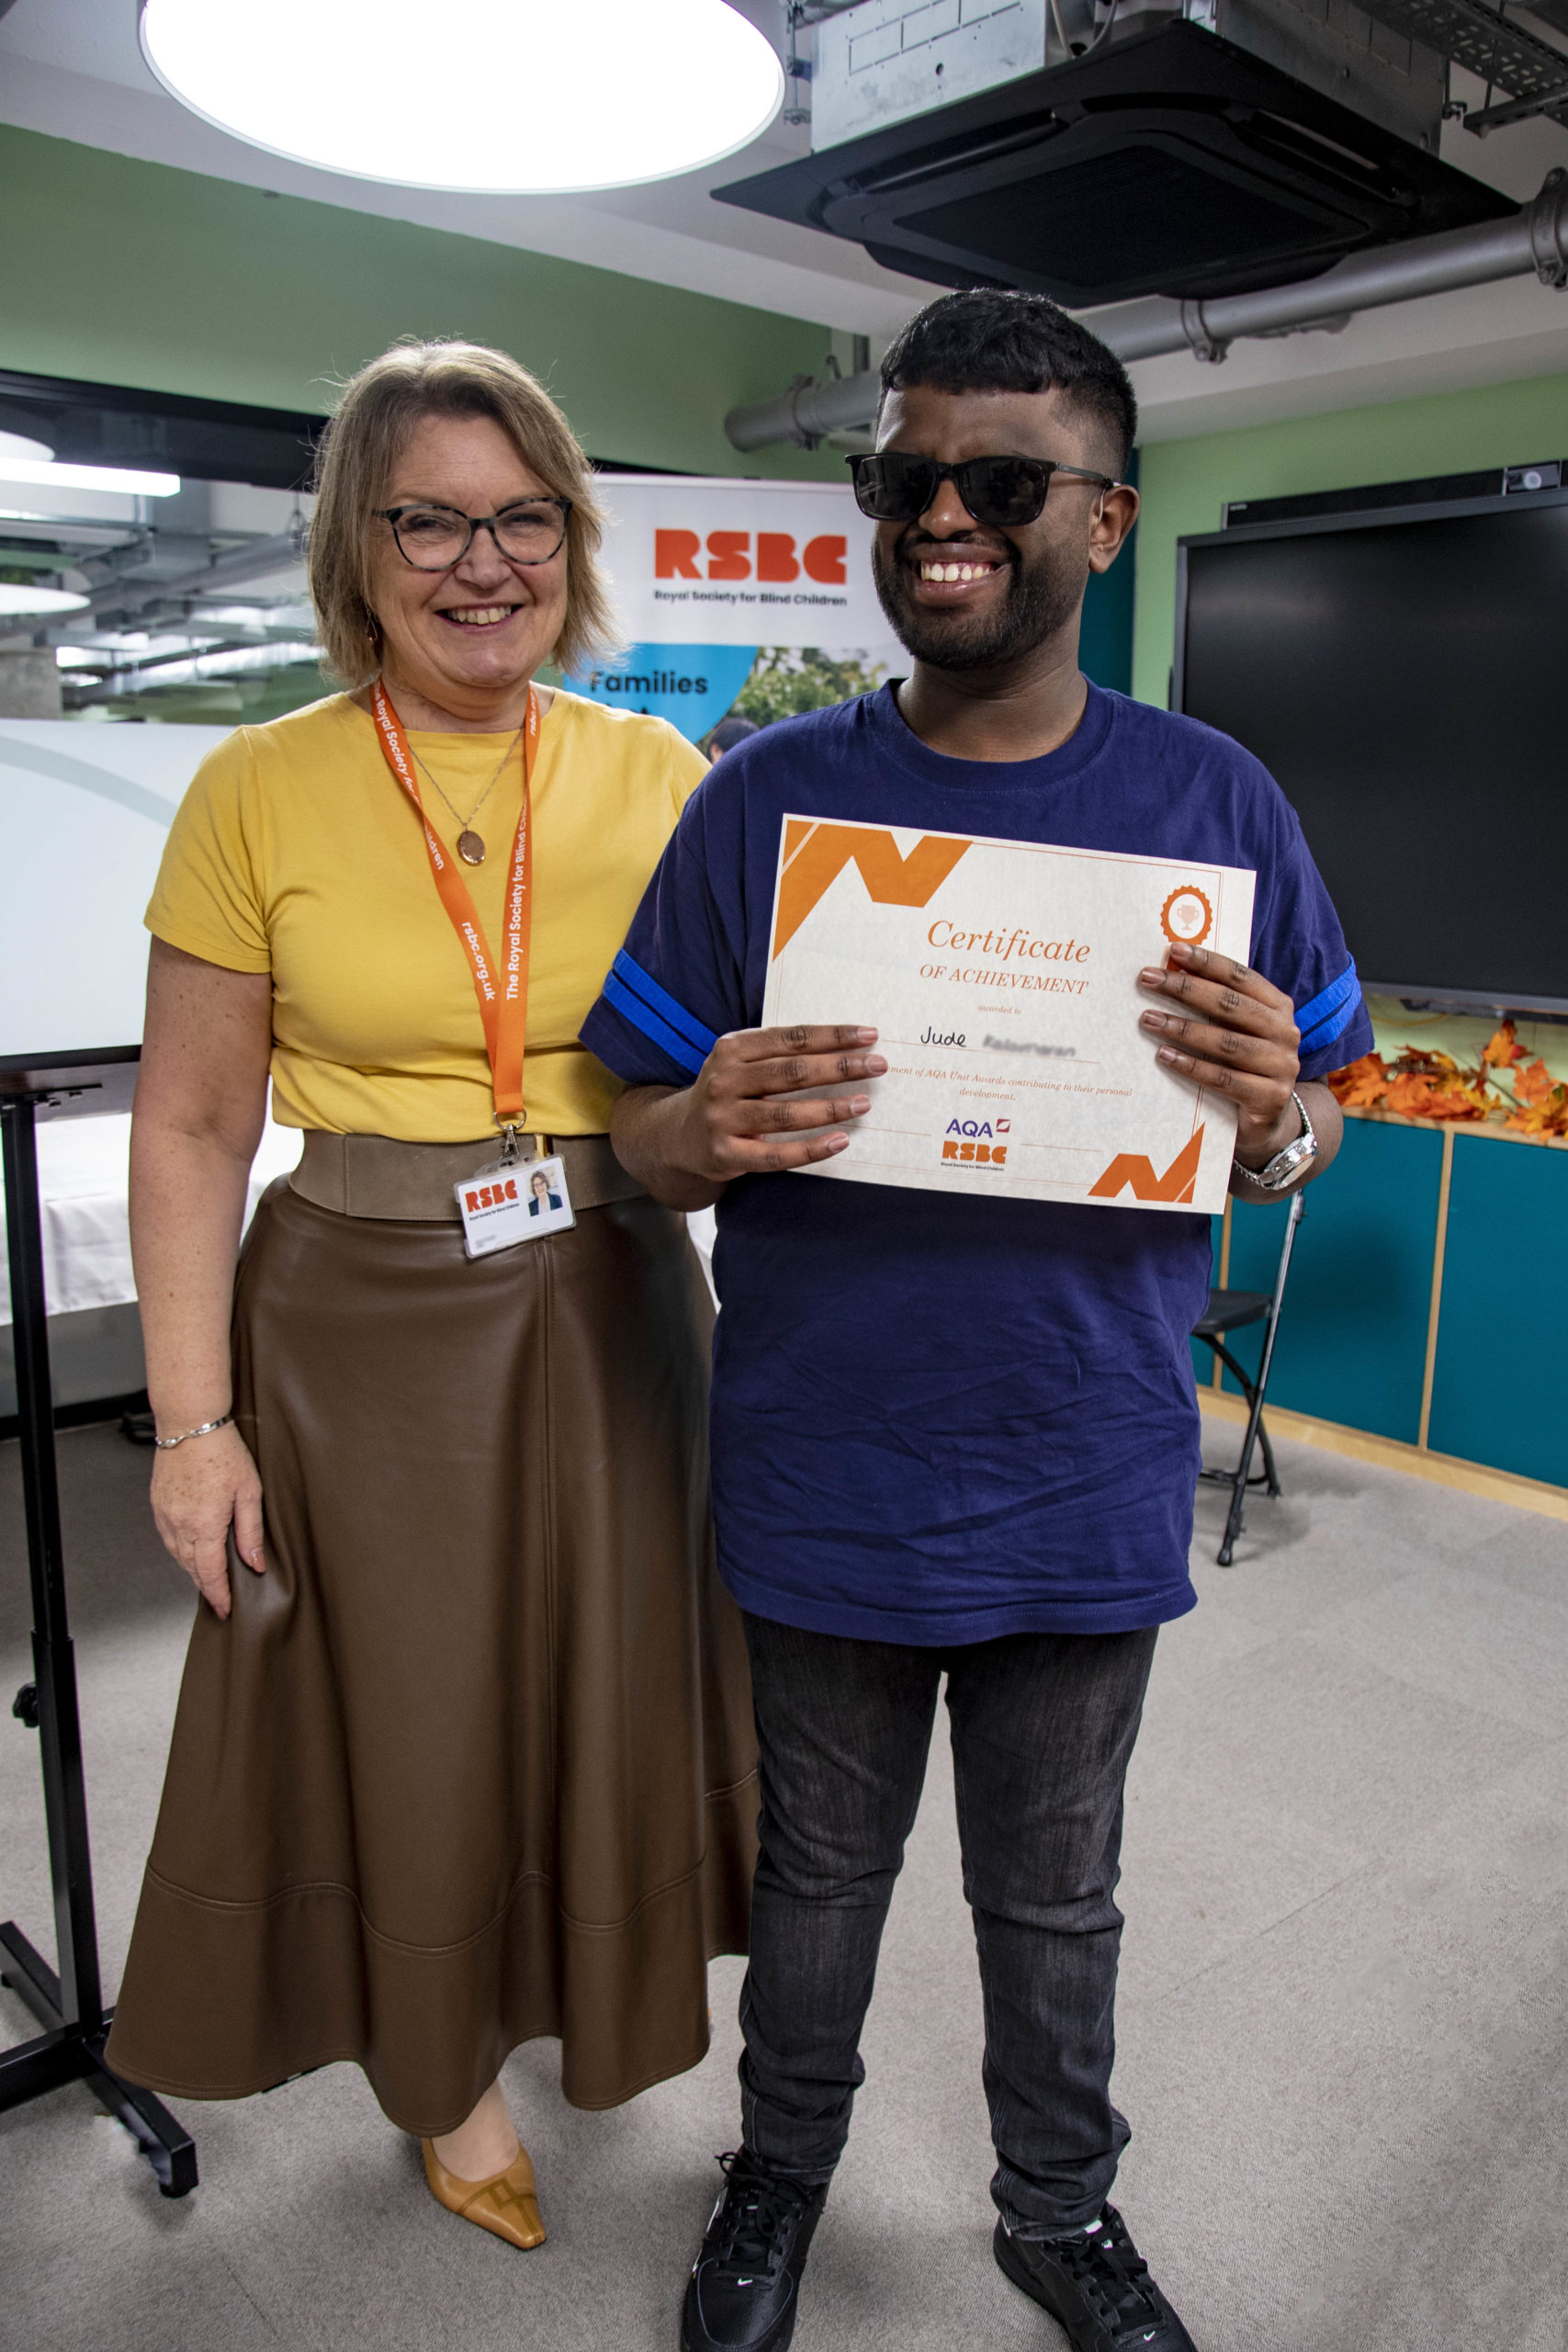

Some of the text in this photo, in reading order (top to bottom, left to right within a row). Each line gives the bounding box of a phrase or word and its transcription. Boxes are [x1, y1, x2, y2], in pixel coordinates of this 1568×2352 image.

[654, 528, 848, 585] RSBC
[654, 589, 848, 606] Royal Society for Blind Children
[590, 671, 708, 694] Families
[376, 699, 396, 731] Royal
[386, 731, 409, 775] Society
[404, 776, 415, 794] for
[515, 831, 526, 863] Blind
[512, 865, 524, 881] for
[509, 883, 526, 931] Society
[508, 933, 525, 971] Royal
[928, 920, 1091, 963] Certificate
[461, 922, 496, 1001] rsbc.org.uk
[506, 974, 519, 1001] The
[919, 964, 1089, 995] OF ACHIEVEMENT
[977, 1004, 1022, 1015] awarded to
[920, 1025, 967, 1047] Jude
[915, 1068, 926, 1078] of
[925, 1069, 947, 1080] AQA
[950, 1071, 970, 1081] Unit
[972, 1074, 1006, 1085] Awards
[1008, 1078, 1062, 1091] contributing
[1074, 1084, 1095, 1093] their
[1095, 1088, 1134, 1097] personal
[959, 1088, 1016, 1102] development.
[945, 1118, 994, 1138] AQA
[942, 1140, 1008, 1165] RSBC
[465, 1179, 519, 1213] RSBC
